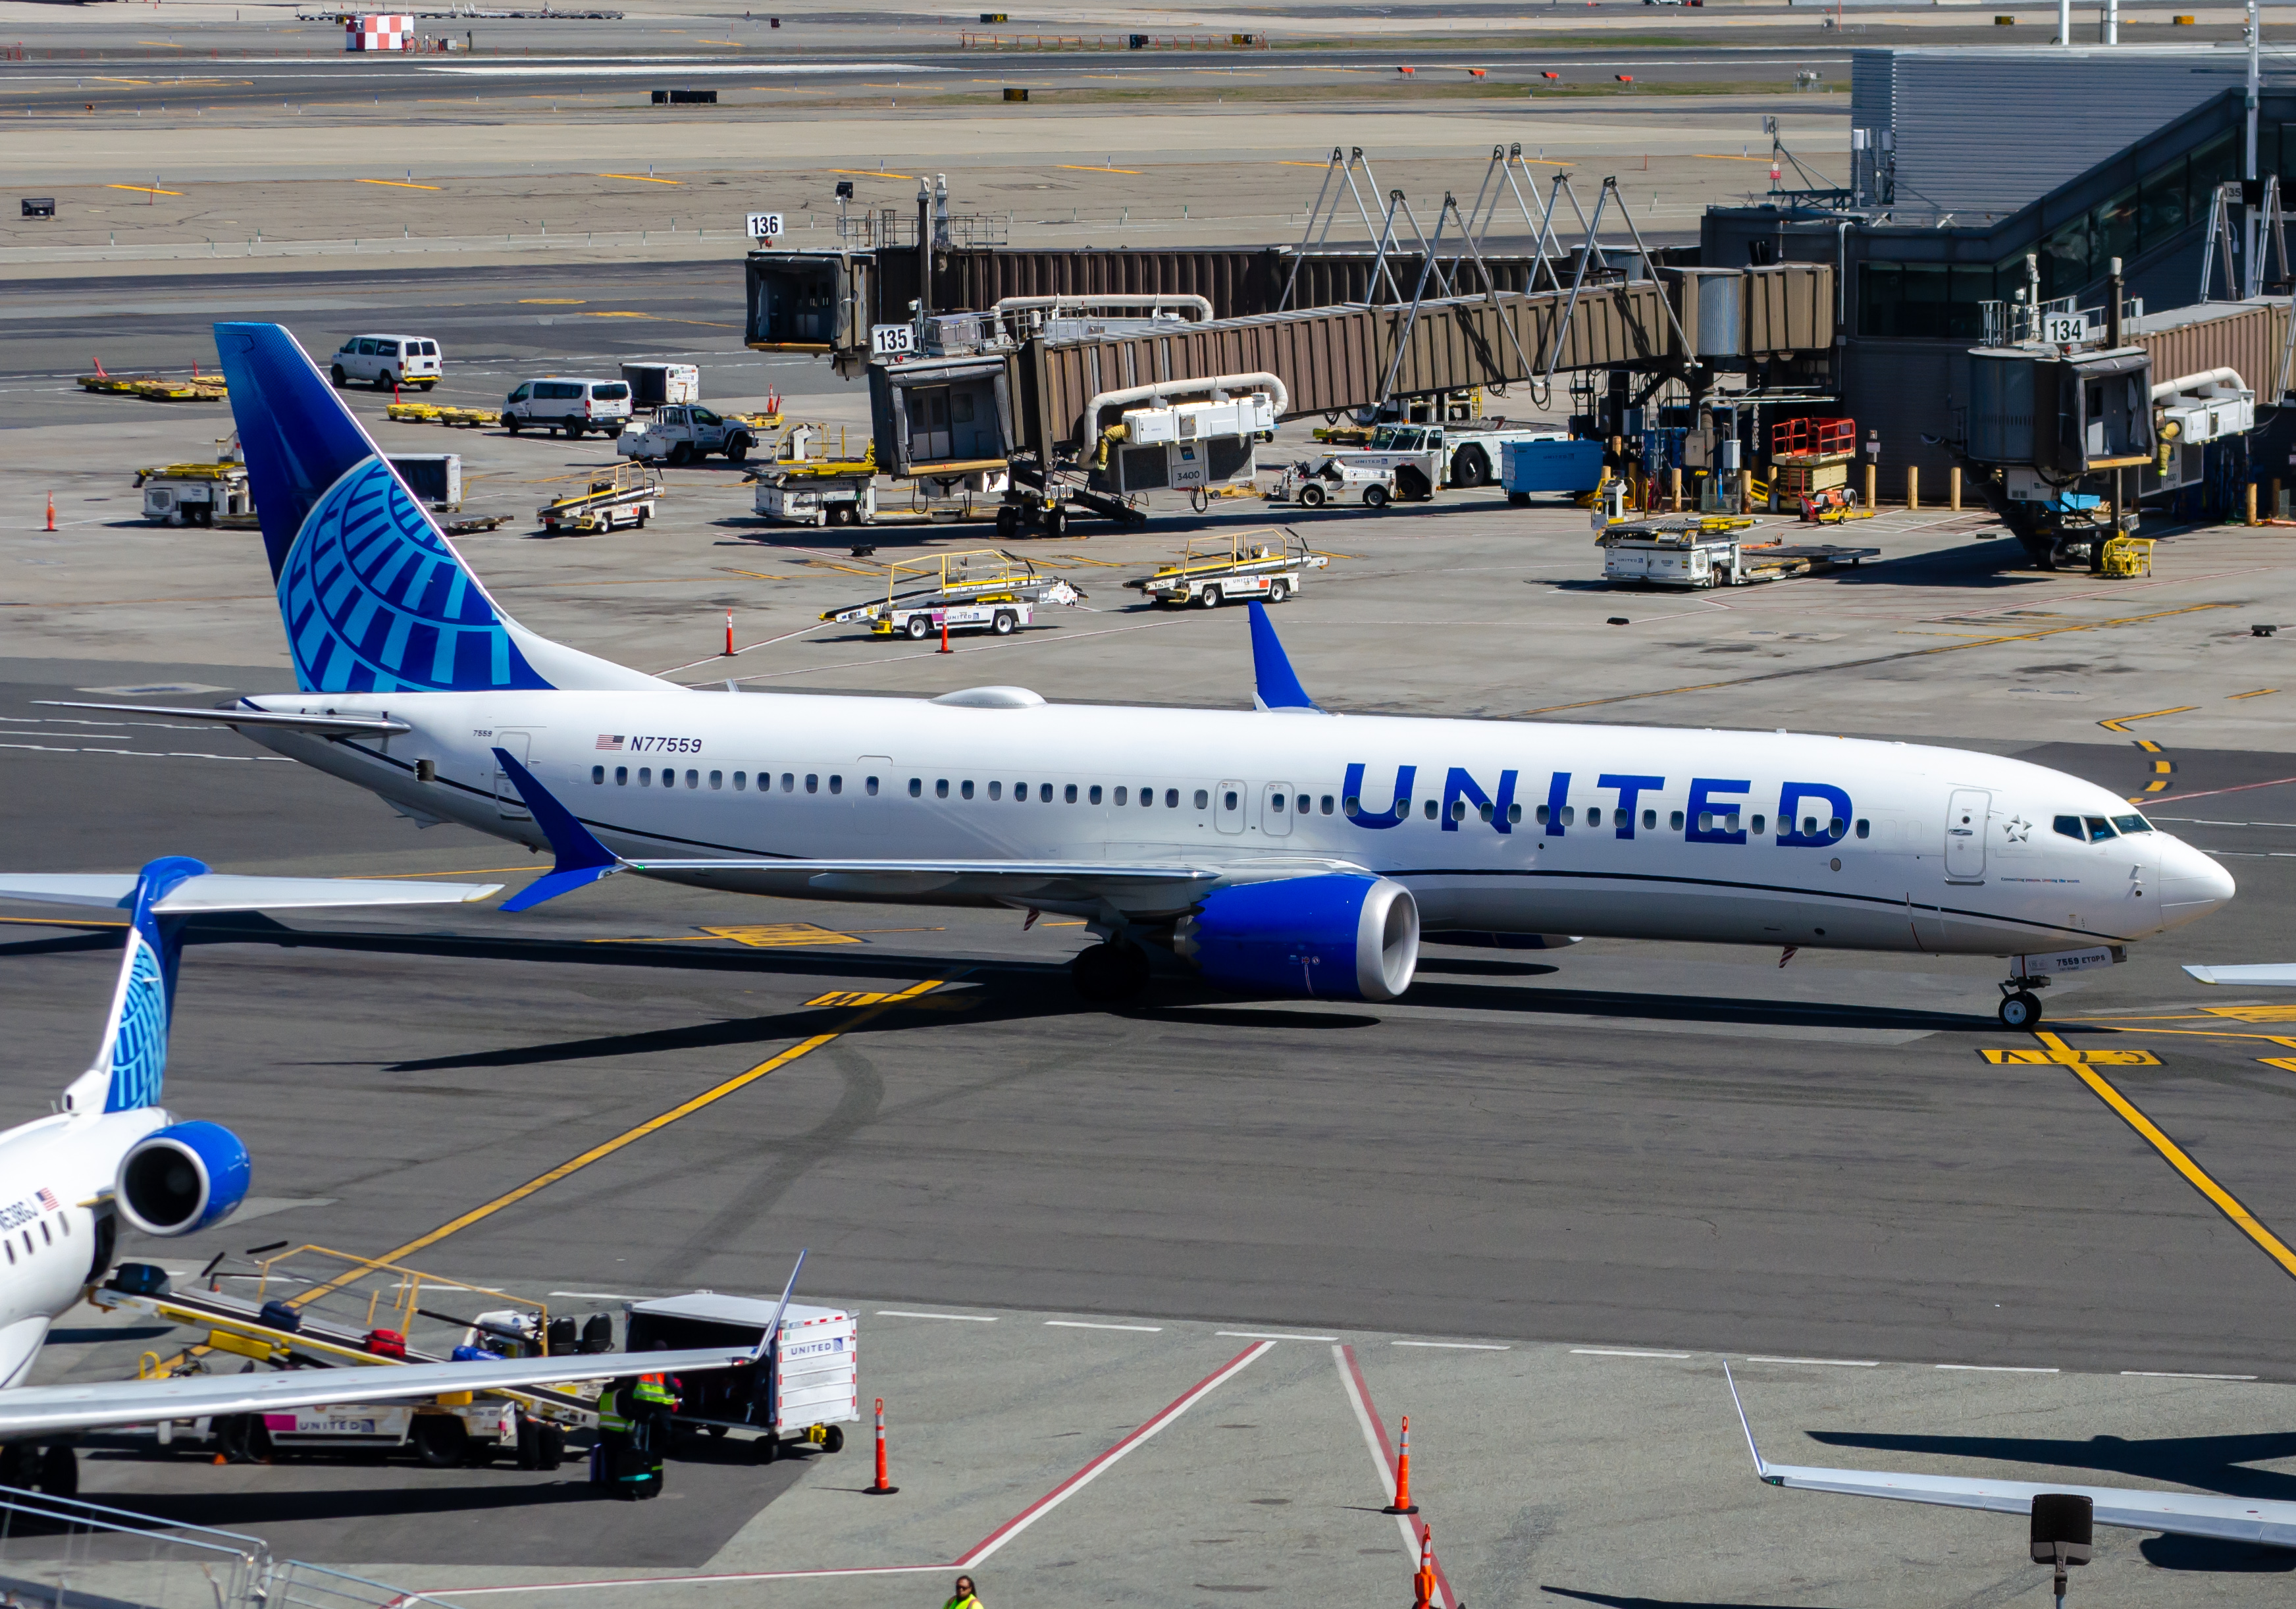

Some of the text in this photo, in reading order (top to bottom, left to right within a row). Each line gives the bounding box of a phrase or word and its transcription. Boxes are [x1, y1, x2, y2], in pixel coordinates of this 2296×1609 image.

[752, 216, 778, 235] 136
[2050, 319, 2082, 341] 134
[877, 328, 908, 351] 135
[1177, 471, 1200, 481] 3400
[631, 735, 702, 753] N77559
[1342, 762, 1853, 848] UNITED
[2056, 955, 2106, 966] 7559 ETOPS
[791, 1342, 831, 1356] UNITED
[299, 1419, 359, 1431] UNITED
